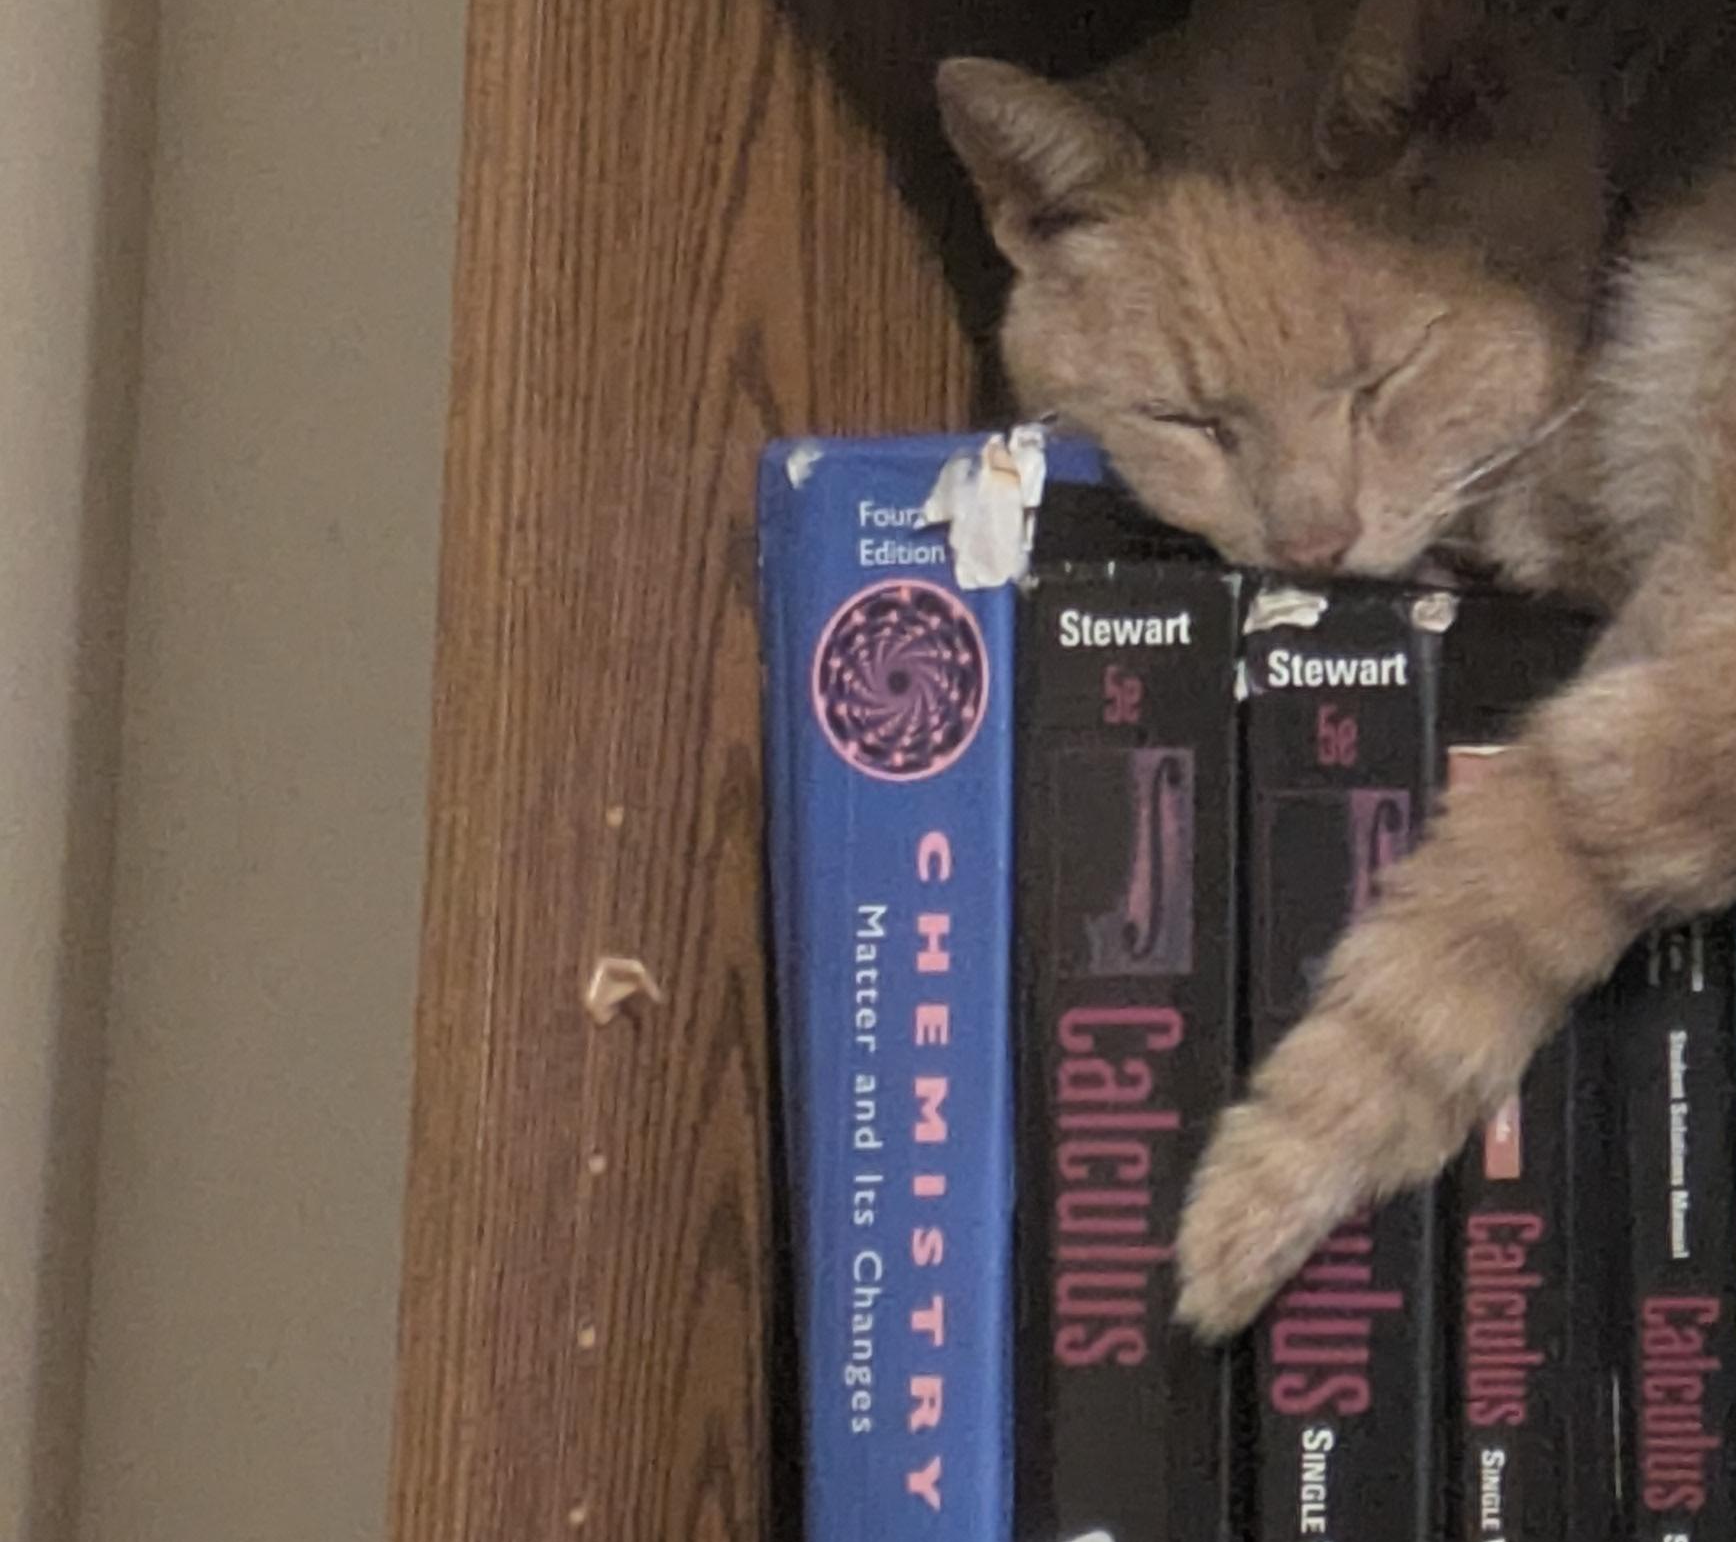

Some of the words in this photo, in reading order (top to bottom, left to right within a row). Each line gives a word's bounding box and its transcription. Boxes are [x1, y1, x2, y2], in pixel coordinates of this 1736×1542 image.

[859, 539, 947, 566] Edition
[1058, 610, 1192, 648] Stewart
[1268, 649, 1407, 687] Stewart
[855, 904, 888, 1054] Matter
[854, 1074, 883, 1150] and
[853, 1174, 883, 1227] Its
[906, 830, 953, 1513] CHEMISTRY
[1053, 1005, 1186, 1368] Calculus
[844, 1251, 883, 1436] Changes
[1465, 1212, 1546, 1428] Calculus
[1640, 1296, 1722, 1513] Calculus
[1301, 1427, 1335, 1534] SINGLE
[1481, 1449, 1506, 1532] SINGLE
